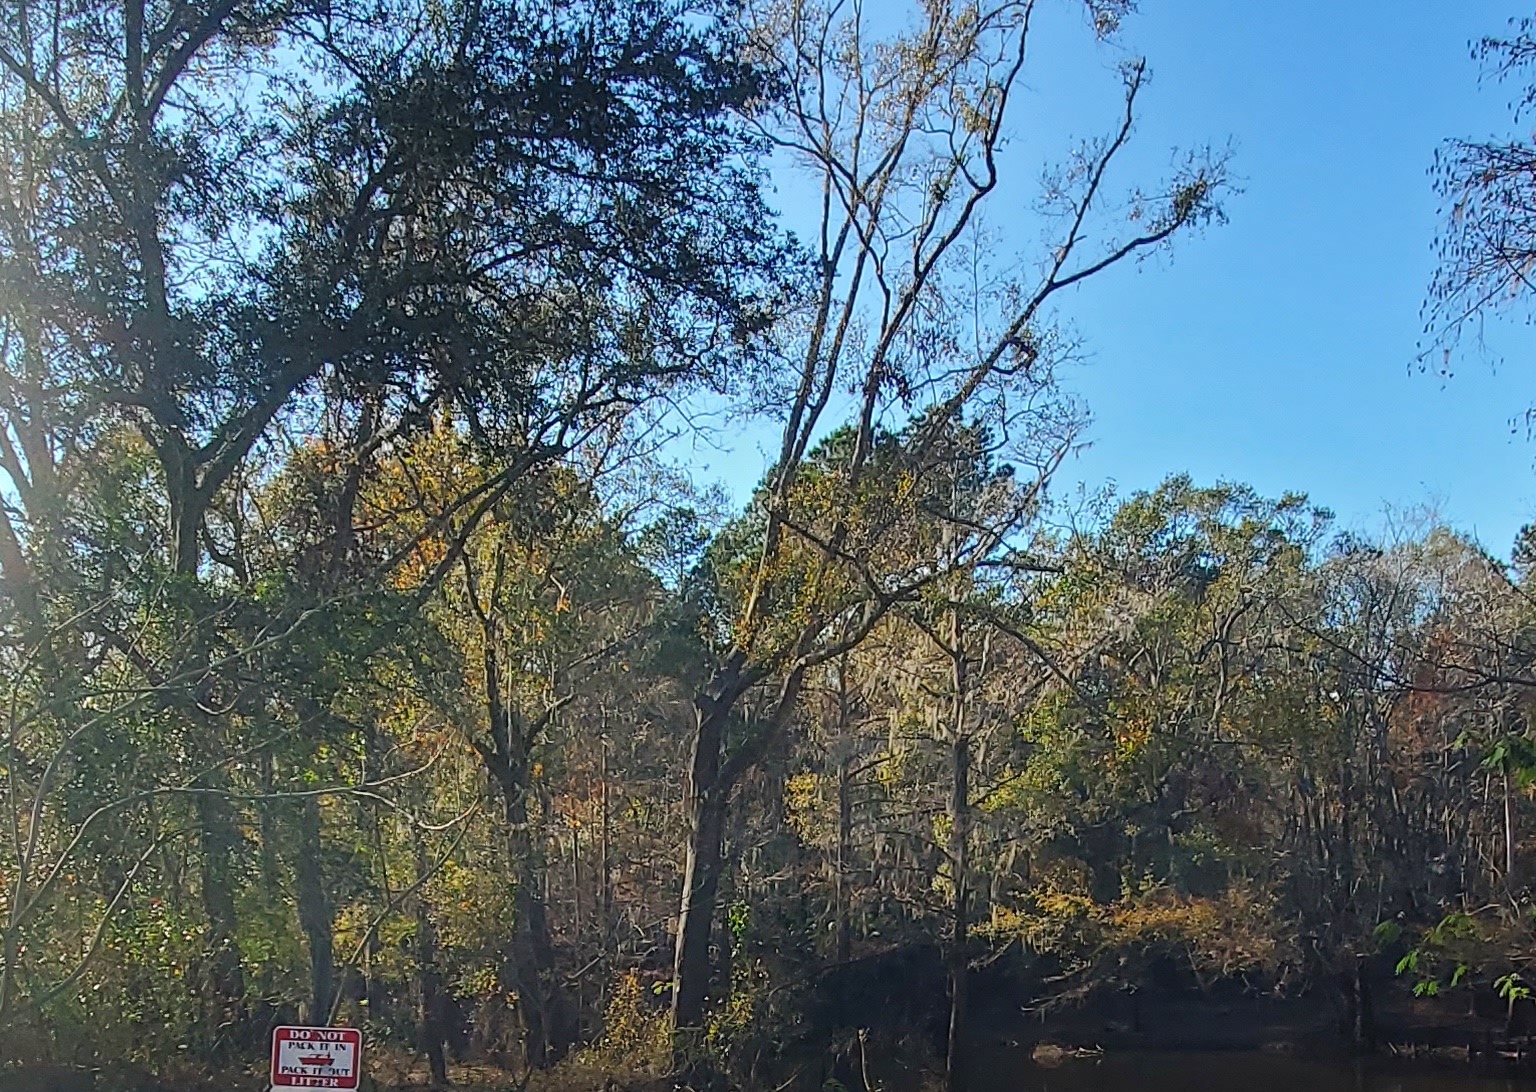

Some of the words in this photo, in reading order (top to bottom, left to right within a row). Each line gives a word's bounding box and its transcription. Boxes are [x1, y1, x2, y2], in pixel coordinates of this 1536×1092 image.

[290, 1030, 311, 1040] DO
[317, 1031, 346, 1041] NOT
[288, 1041, 315, 1051] PACK
[319, 1042, 330, 1051] IT
[335, 1043, 346, 1051] IN
[281, 1066, 308, 1075] PACK
[313, 1067, 322, 1075] IT
[291, 1076, 339, 1087] LITTER
